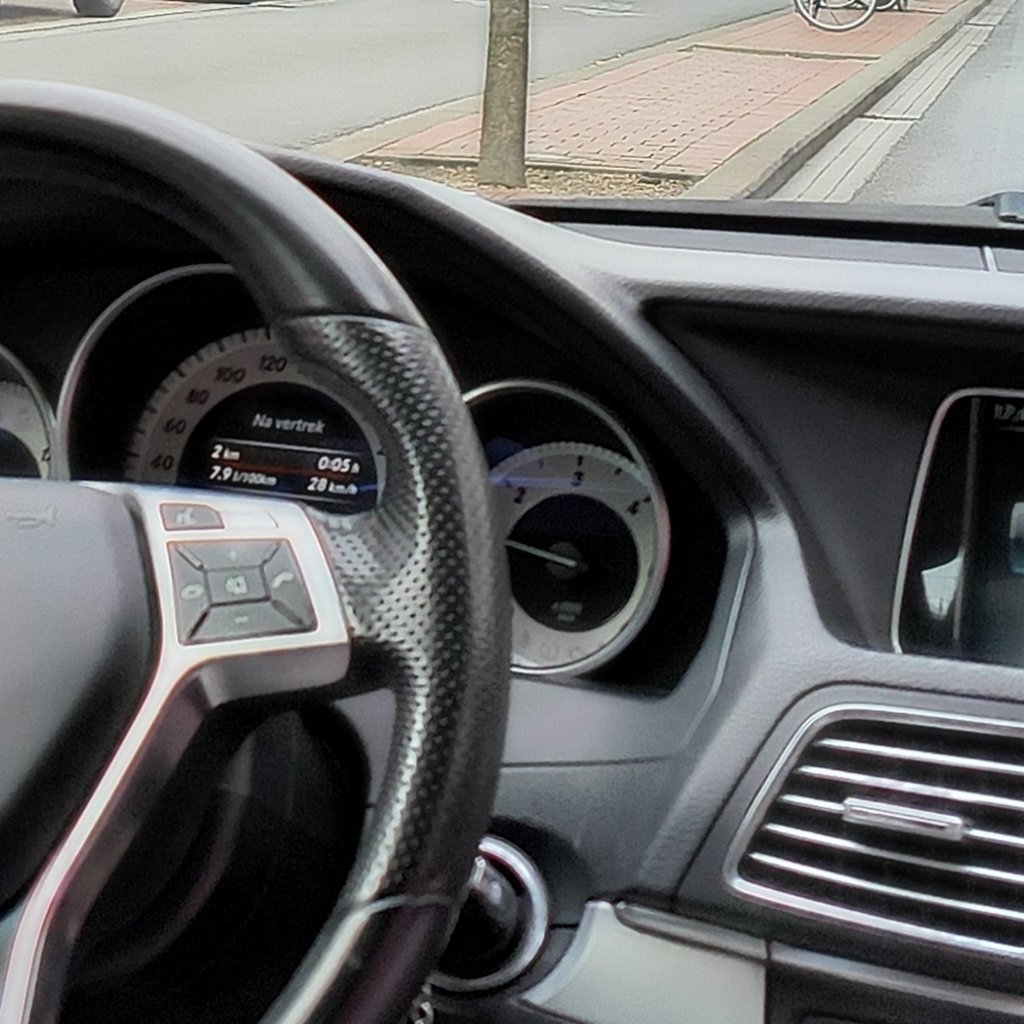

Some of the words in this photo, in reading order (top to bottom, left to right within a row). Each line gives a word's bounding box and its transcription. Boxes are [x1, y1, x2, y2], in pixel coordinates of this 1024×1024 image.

[259, 354, 288, 372] 120
[215, 367, 246, 384] 100
[185, 388, 211, 406] 80
[165, 419, 188, 434] 60
[252, 413, 273, 428] Na
[276, 418, 326, 434] vertrek
[210, 444, 224, 459] 2
[150, 454, 174, 471] 40
[209, 465, 233, 481] 7.9
